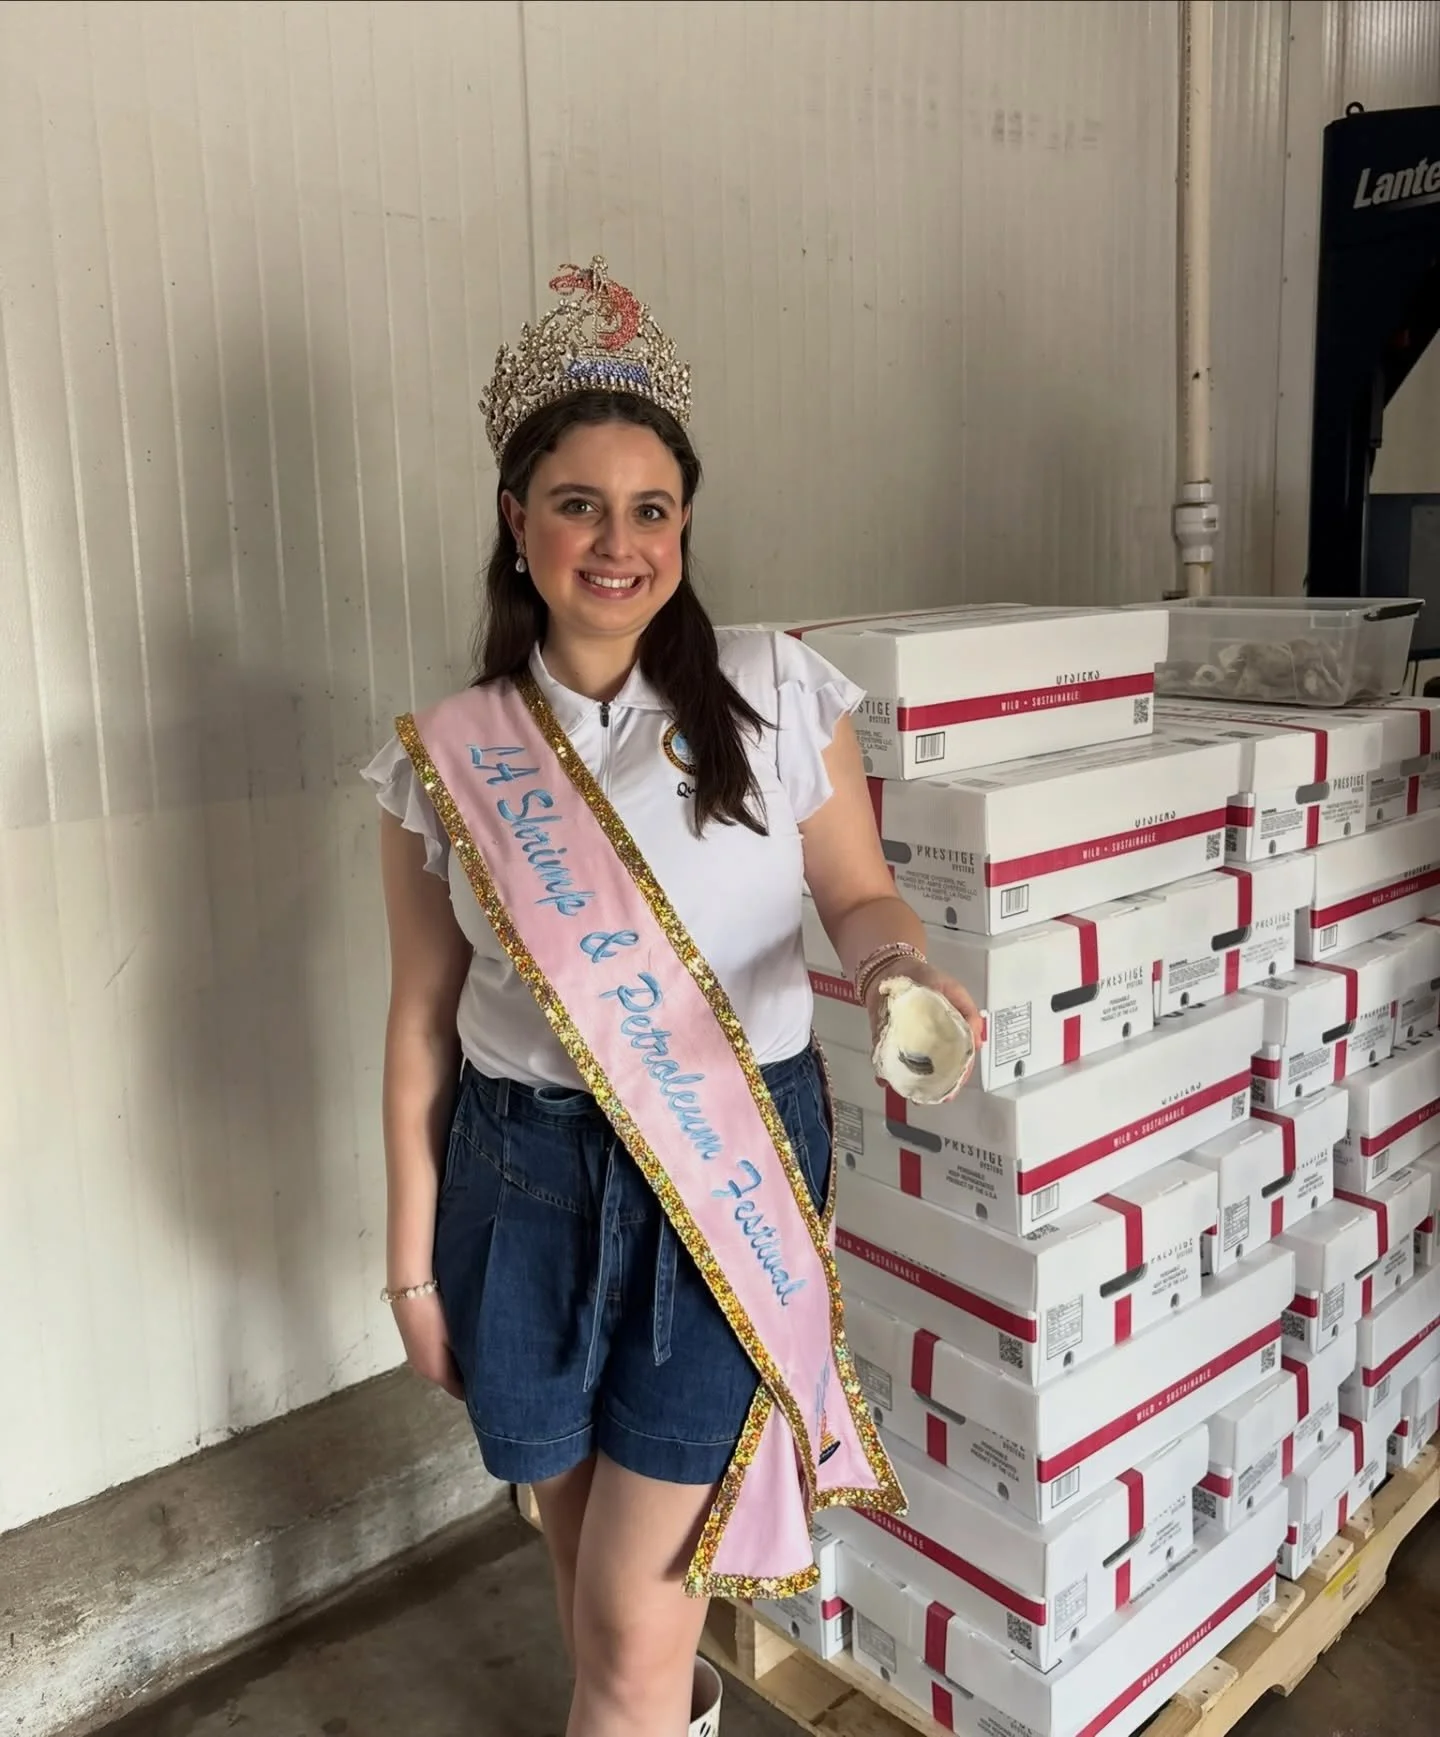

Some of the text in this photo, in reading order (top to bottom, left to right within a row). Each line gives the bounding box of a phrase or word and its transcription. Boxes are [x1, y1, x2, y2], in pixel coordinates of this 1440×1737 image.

[1353, 158, 1440, 209] Lante
[856, 700, 891, 717] STIGE
[1031, 690, 1081, 708] SUSTAINABLE
[1333, 774, 1365, 791] PRESTIGE
[1111, 832, 1156, 853] SUSTAINABLE
[916, 844, 975, 866] PRESTIGE
[814, 979, 853, 999] SUSTAINA
[465, 744, 807, 1308] LA Shrimp & Petroleum Festival
[944, 1136, 1003, 1168] PRESTIGE
